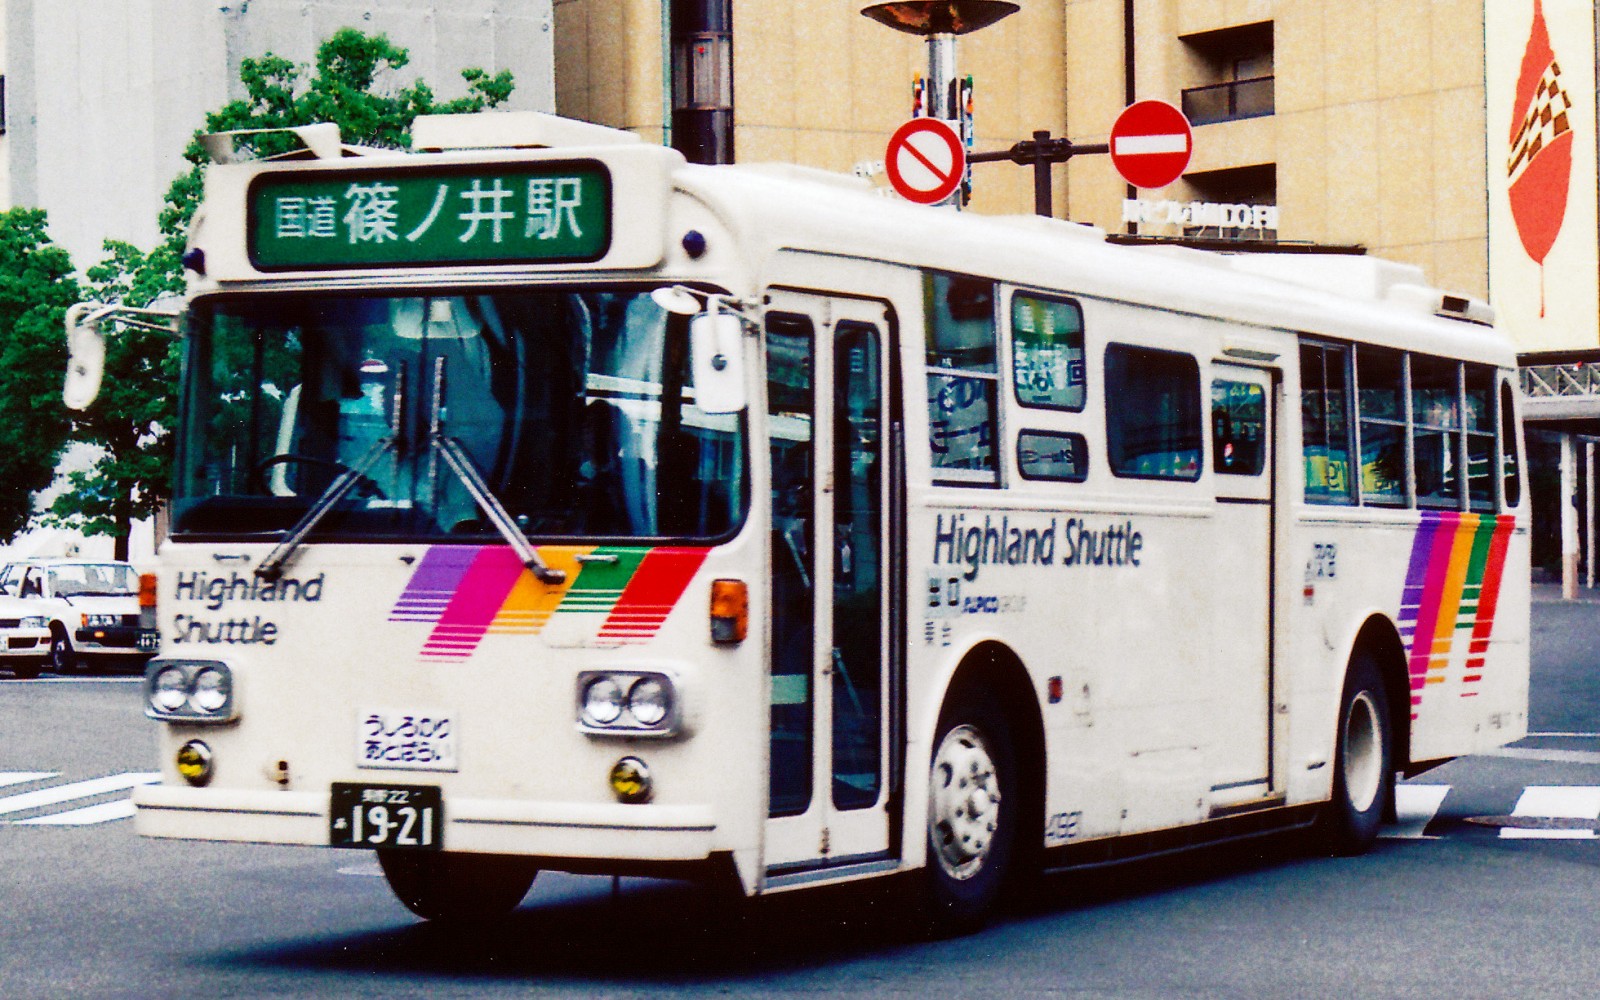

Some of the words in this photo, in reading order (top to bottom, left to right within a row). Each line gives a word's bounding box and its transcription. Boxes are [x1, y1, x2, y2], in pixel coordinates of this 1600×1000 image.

[275, 195, 337, 239] 国道
[342, 176, 583, 244] 篠ノ井駅
[932, 513, 1056, 582] Highland
[1062, 517, 1143, 567] Shuttle
[175, 571, 325, 611] Highland
[173, 613, 278, 645] Shuttle
[363, 713, 450, 739] うしろのり
[352, 804, 434, 846] 19-21
